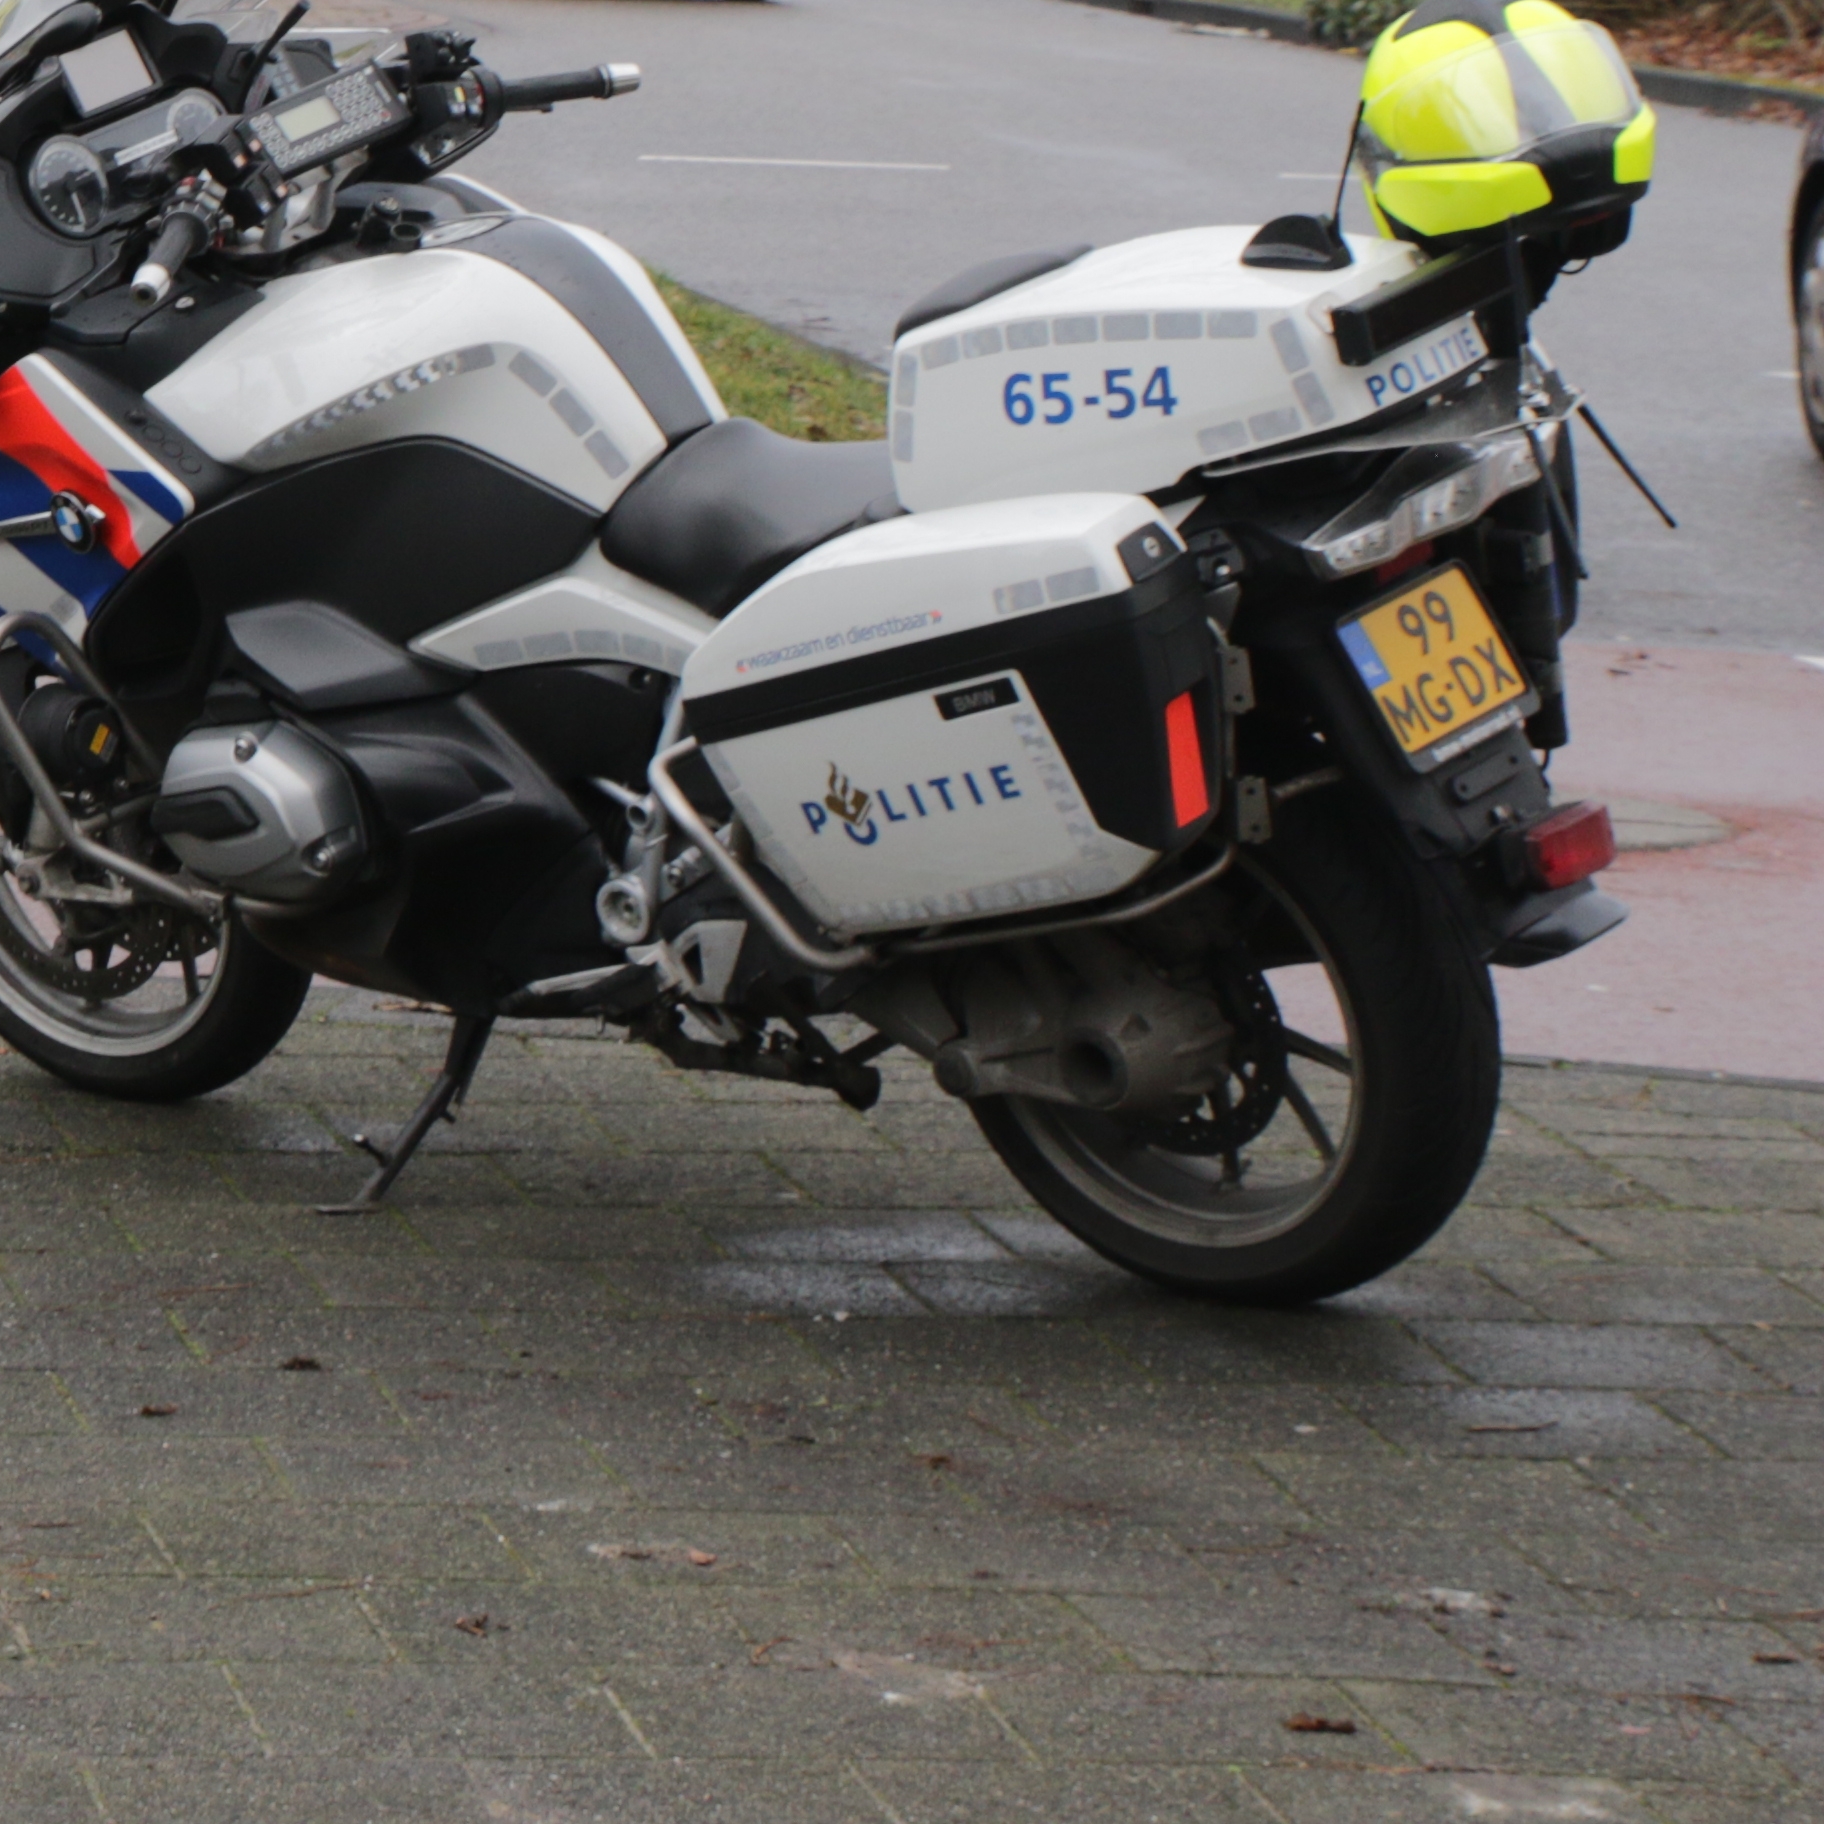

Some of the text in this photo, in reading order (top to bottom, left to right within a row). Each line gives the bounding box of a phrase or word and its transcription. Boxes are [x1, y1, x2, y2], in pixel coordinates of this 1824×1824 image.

[1003, 366, 1178, 426] 65-54
[1364, 327, 1480, 407] POLITIE
[1397, 590, 1454, 656] 99
[952, 687, 997, 713] BMW
[1381, 638, 1516, 744] MG-DX
[801, 764, 1022, 846] POLITIE
